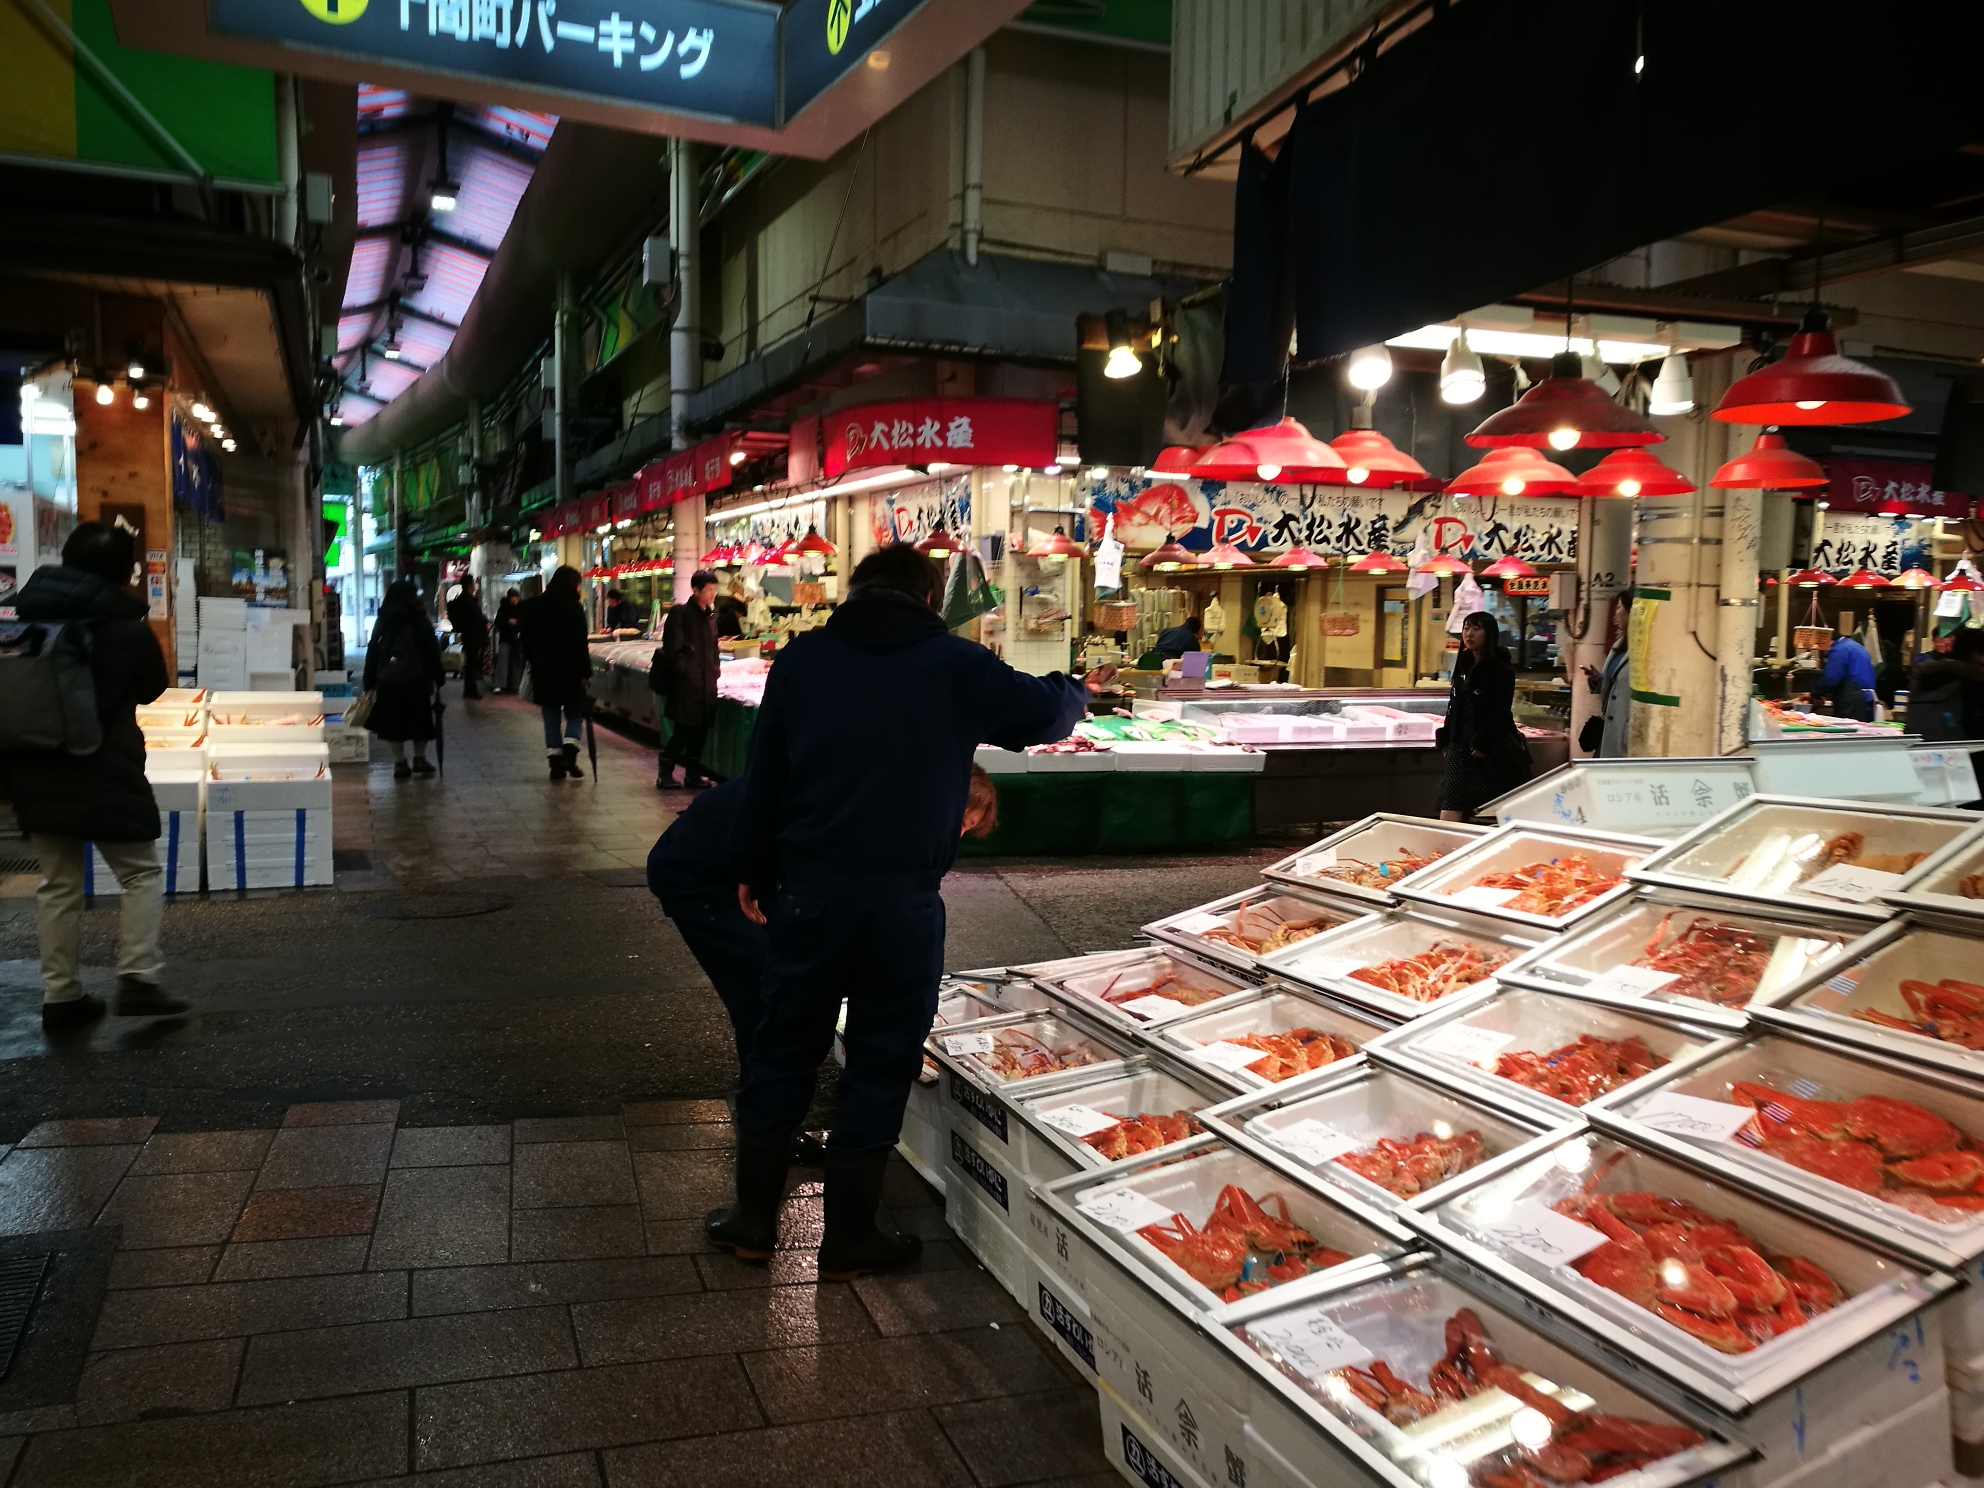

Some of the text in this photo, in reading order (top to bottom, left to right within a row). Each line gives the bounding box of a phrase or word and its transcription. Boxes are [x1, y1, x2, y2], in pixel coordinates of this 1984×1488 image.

[869, 416, 974, 451] 大松水産
[1272, 511, 1390, 551] 大松水産
[1813, 539, 1899, 571] 大松水産
[1591, 572, 1615, 588] A2
[1650, 784, 1670, 806] 活
